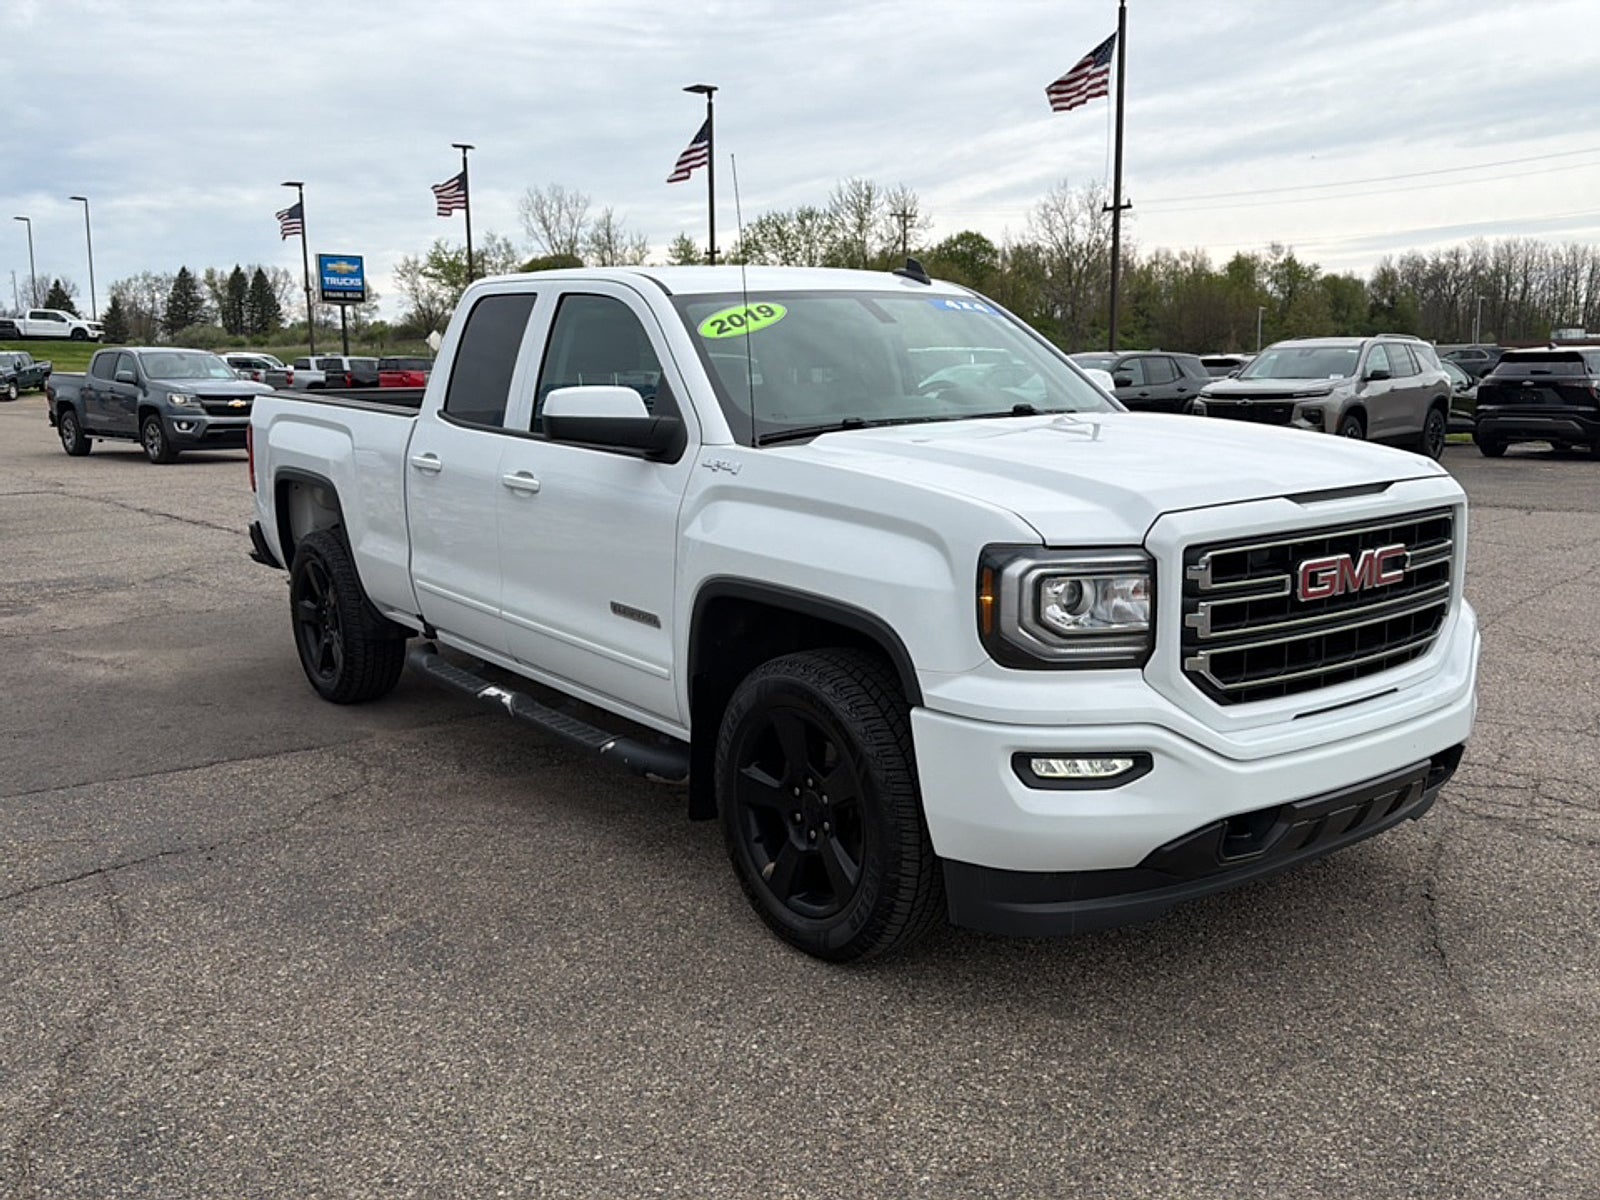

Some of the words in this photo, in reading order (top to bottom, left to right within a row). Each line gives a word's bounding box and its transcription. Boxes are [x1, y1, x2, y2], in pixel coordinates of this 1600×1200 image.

[323, 276, 362, 286] TRUCKS
[710, 304, 776, 335] 2019
[1297, 542, 1406, 602] GMC
